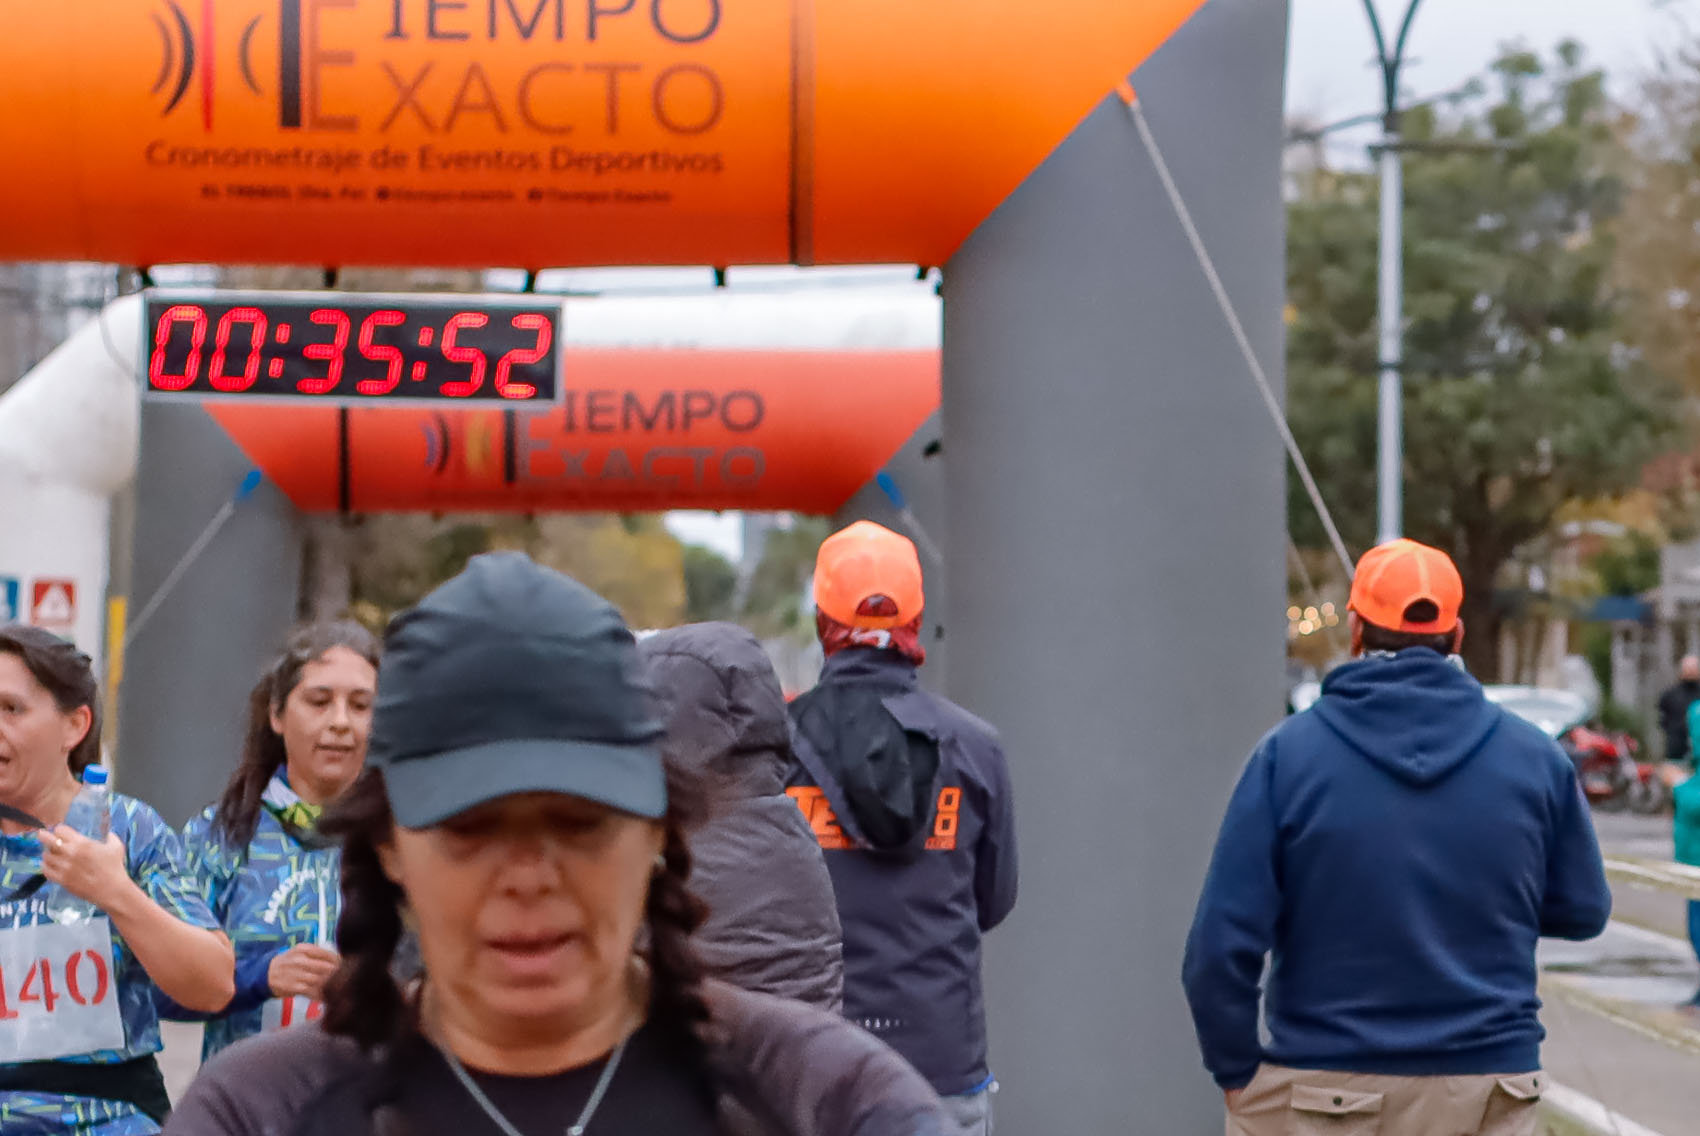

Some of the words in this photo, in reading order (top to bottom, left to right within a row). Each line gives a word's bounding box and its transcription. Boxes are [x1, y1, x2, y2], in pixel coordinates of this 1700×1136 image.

[304, 0, 726, 136] EXACTO
[145, 139, 362, 174] Cronometraje
[371, 144, 409, 170] de
[419, 145, 541, 171] Eventos
[550, 145, 724, 176] Deportivos
[149, 305, 553, 400] 00:35:52
[563, 390, 766, 433] IEMPO
